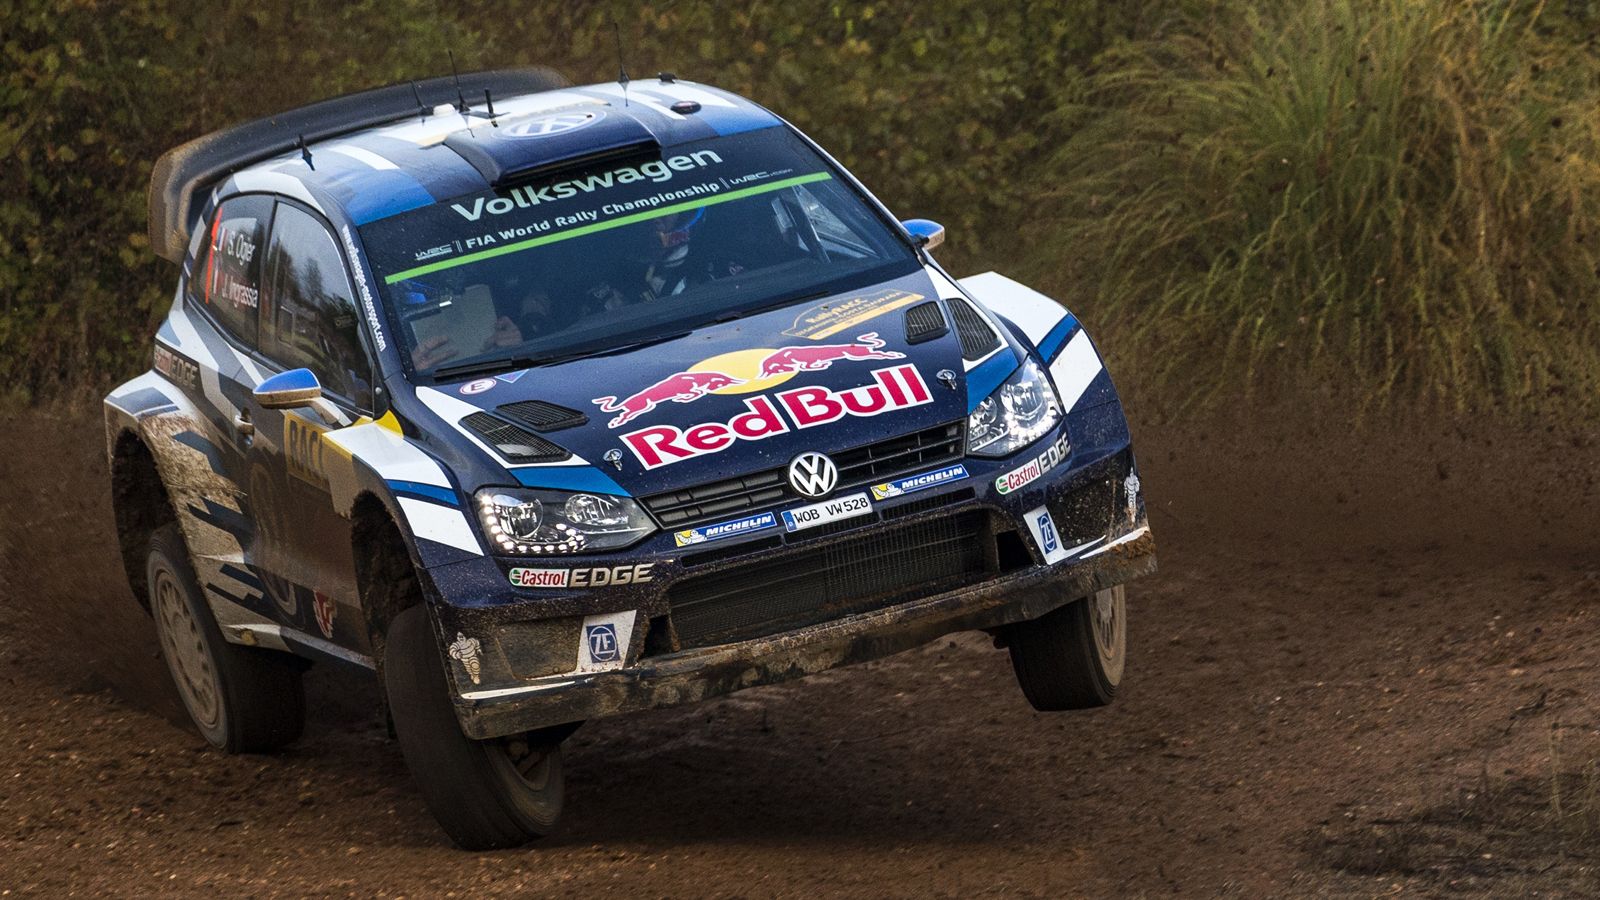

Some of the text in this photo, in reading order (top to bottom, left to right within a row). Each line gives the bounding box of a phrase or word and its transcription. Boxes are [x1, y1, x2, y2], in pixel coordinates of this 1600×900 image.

[451, 149, 723, 222] Volkswagen
[465, 181, 720, 249] FIA World Rally Championship
[236, 233, 256, 266] Ogier
[229, 275, 258, 308] Ingrassia
[342, 223, 387, 352] www.volkswagen-motorsport.com
[470, 381, 486, 392] E
[621, 364, 932, 469] Red Bull
[902, 466, 963, 488] MICHELIN
[1008, 431, 1071, 490] Castrol EDGE
[706, 515, 772, 536] MICHELIN
[794, 497, 869, 524] WOB VW 528
[521, 562, 655, 588] Castrol EDGE
[590, 631, 615, 656] ZF
